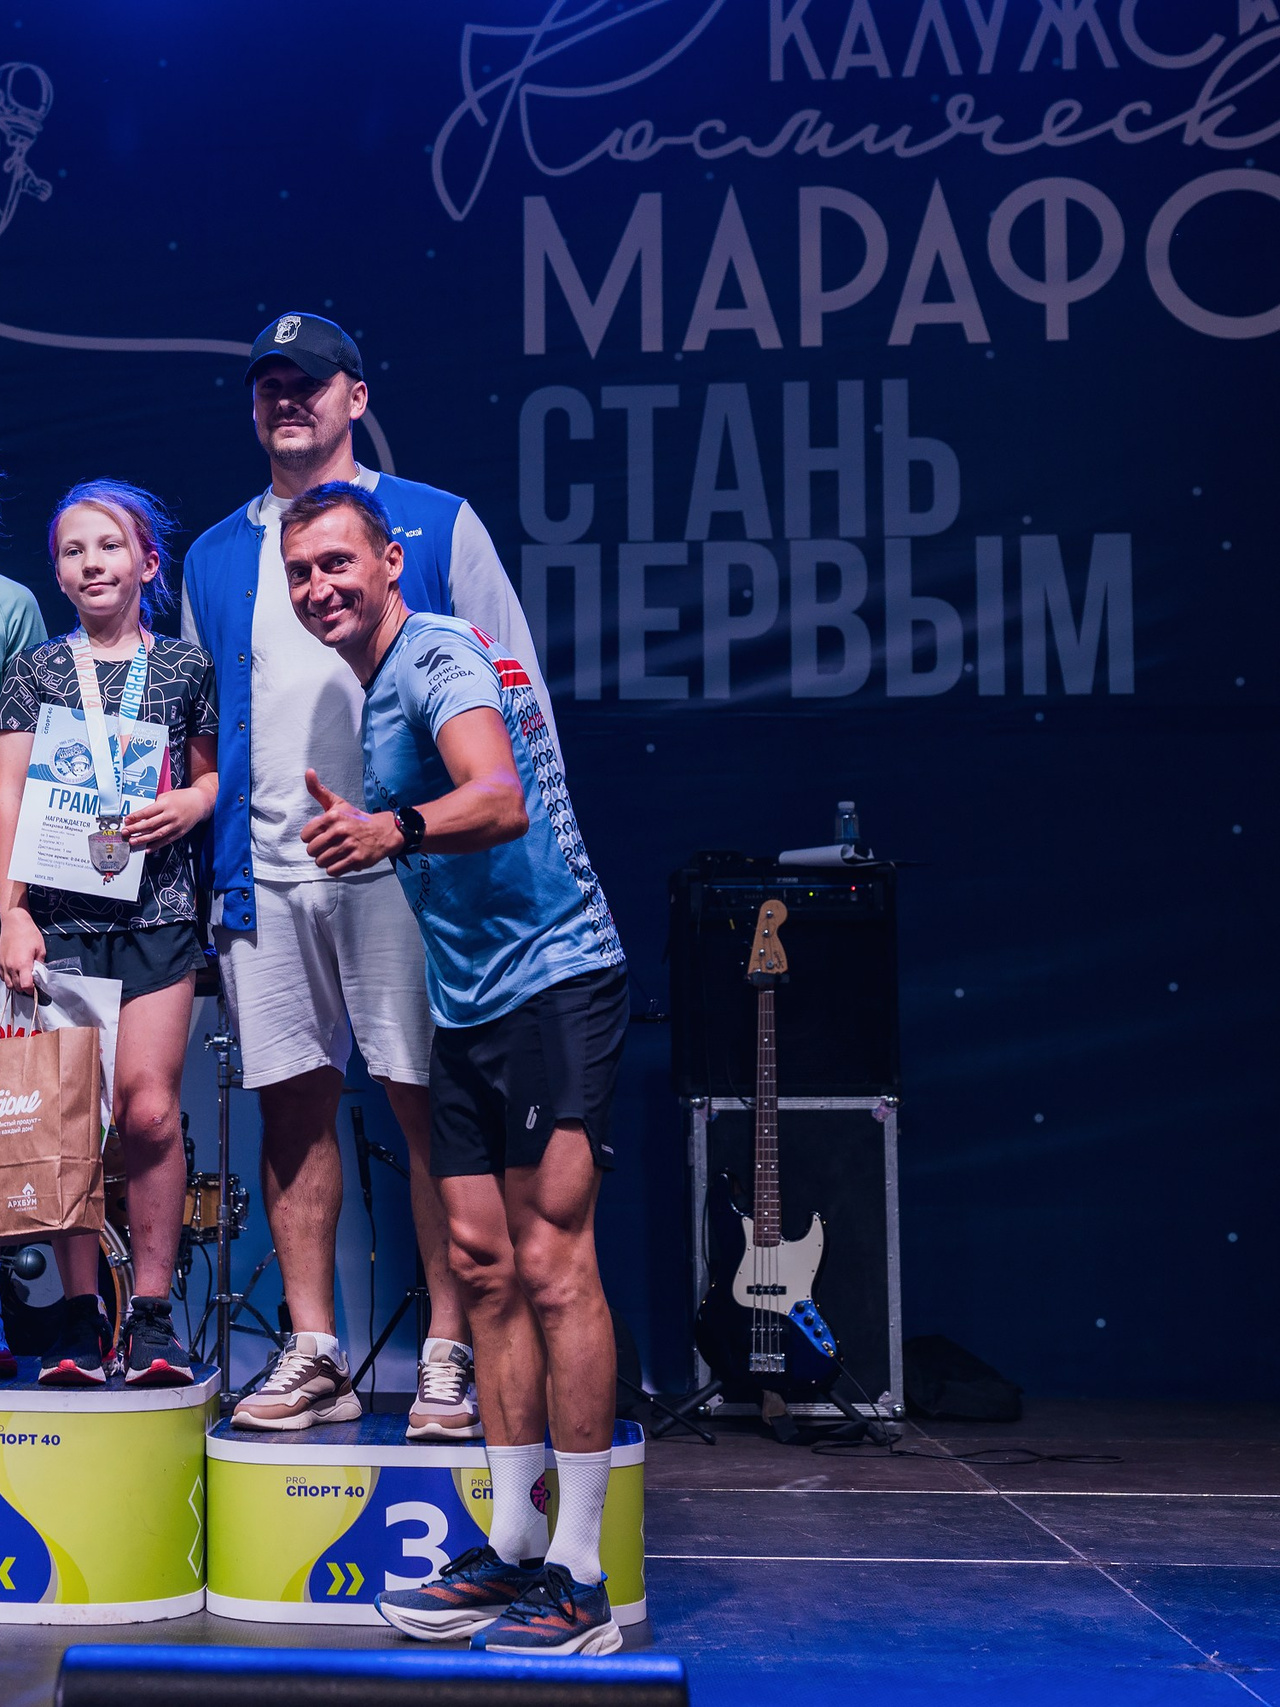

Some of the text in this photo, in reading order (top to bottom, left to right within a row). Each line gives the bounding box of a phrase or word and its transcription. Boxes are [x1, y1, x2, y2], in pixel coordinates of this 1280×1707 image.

[523, 168, 1280, 360] МАРАФО
[519, 378, 961, 545] СТАНЬ
[520, 532, 1135, 702] ПЕРВЫМ
[120, 656, 147, 720] ПЕРВЫМ
[427, 670, 476, 700] ЛЕГКОВА
[428, 664, 461, 686] ГОНКА
[44, 815, 91, 828] НАГРАЖДАЕТСЯ
[41, 1434, 61, 1446] 40
[285, 1476, 307, 1484] PRO
[286, 1485, 365, 1499] СПОРТ 40
[385, 1501, 450, 1592] 3
